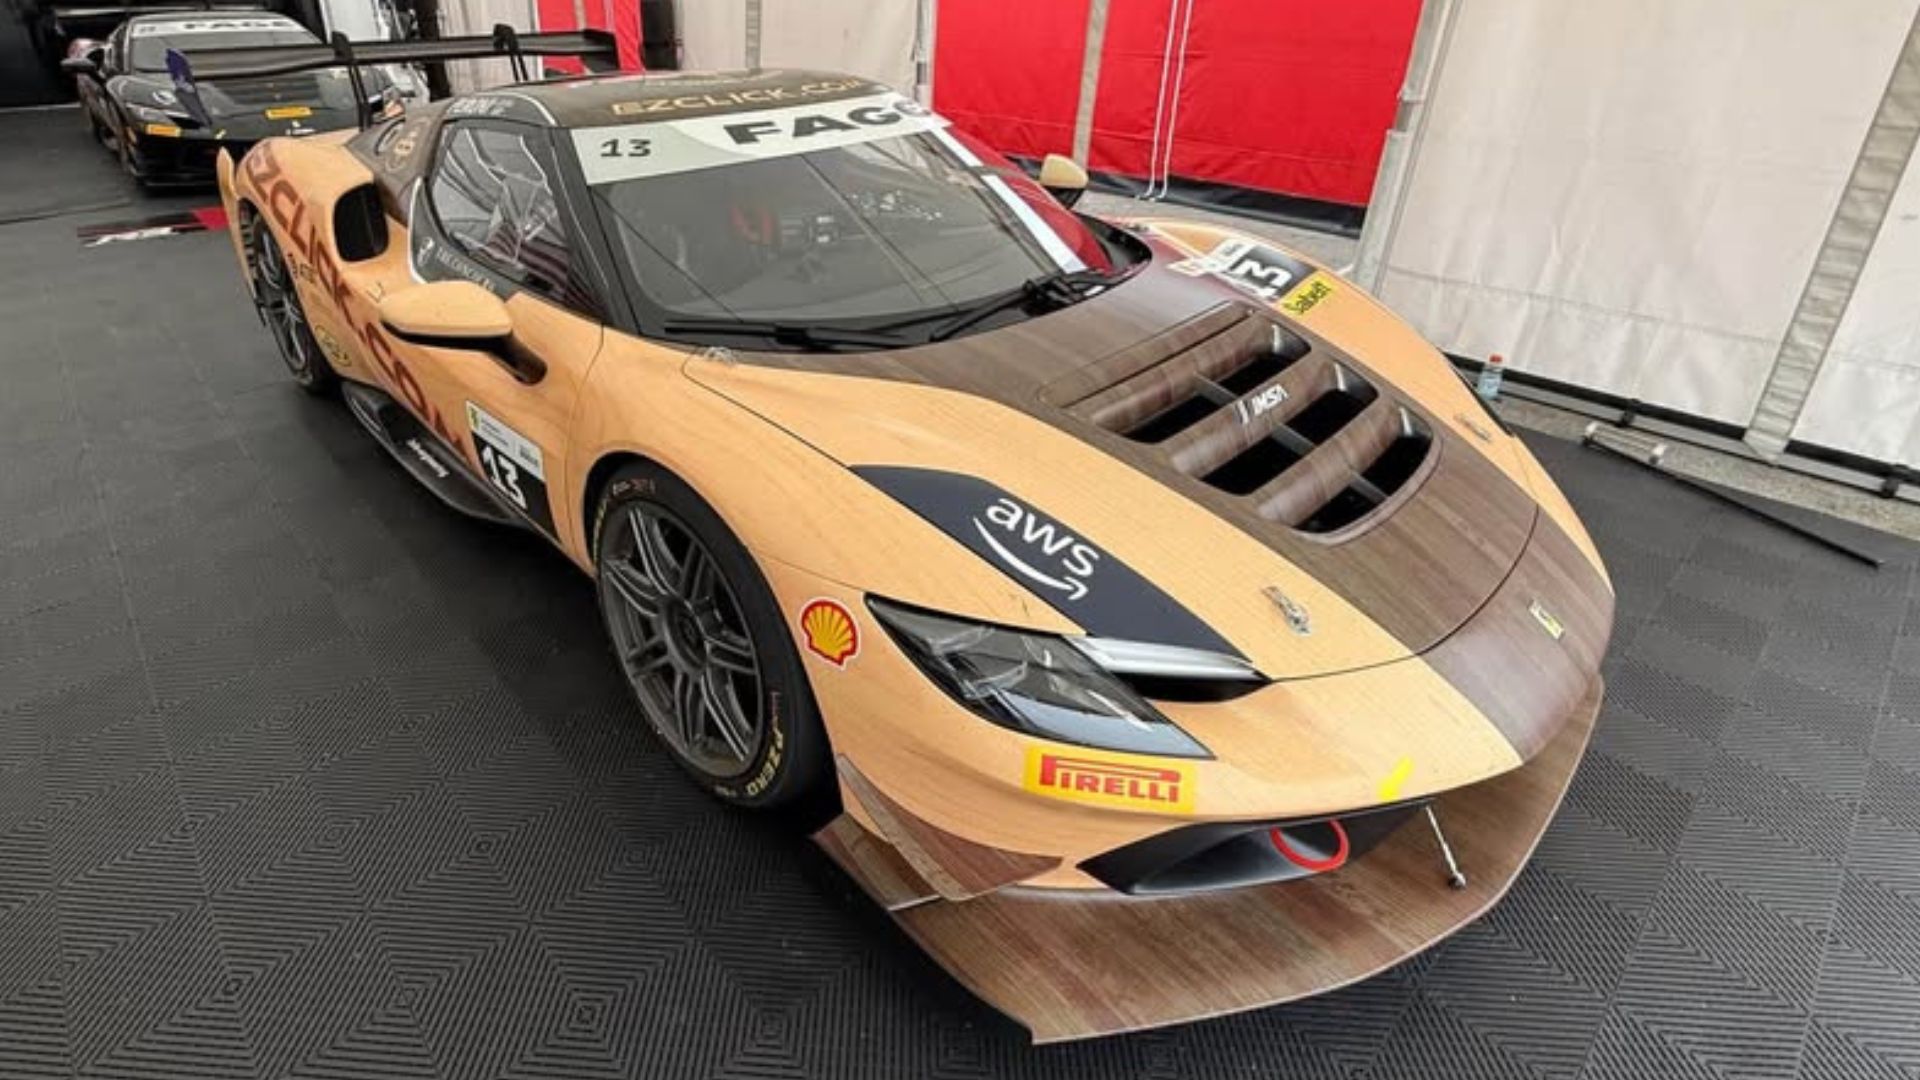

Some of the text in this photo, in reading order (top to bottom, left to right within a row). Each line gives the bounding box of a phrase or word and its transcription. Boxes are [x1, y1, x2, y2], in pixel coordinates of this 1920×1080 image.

[612, 79, 860, 116] EZCLICK.COM
[600, 138, 652, 157] 13
[482, 446, 527, 509] 13
[986, 498, 1099, 577] aws
[1039, 754, 1182, 804] PIRELLI
